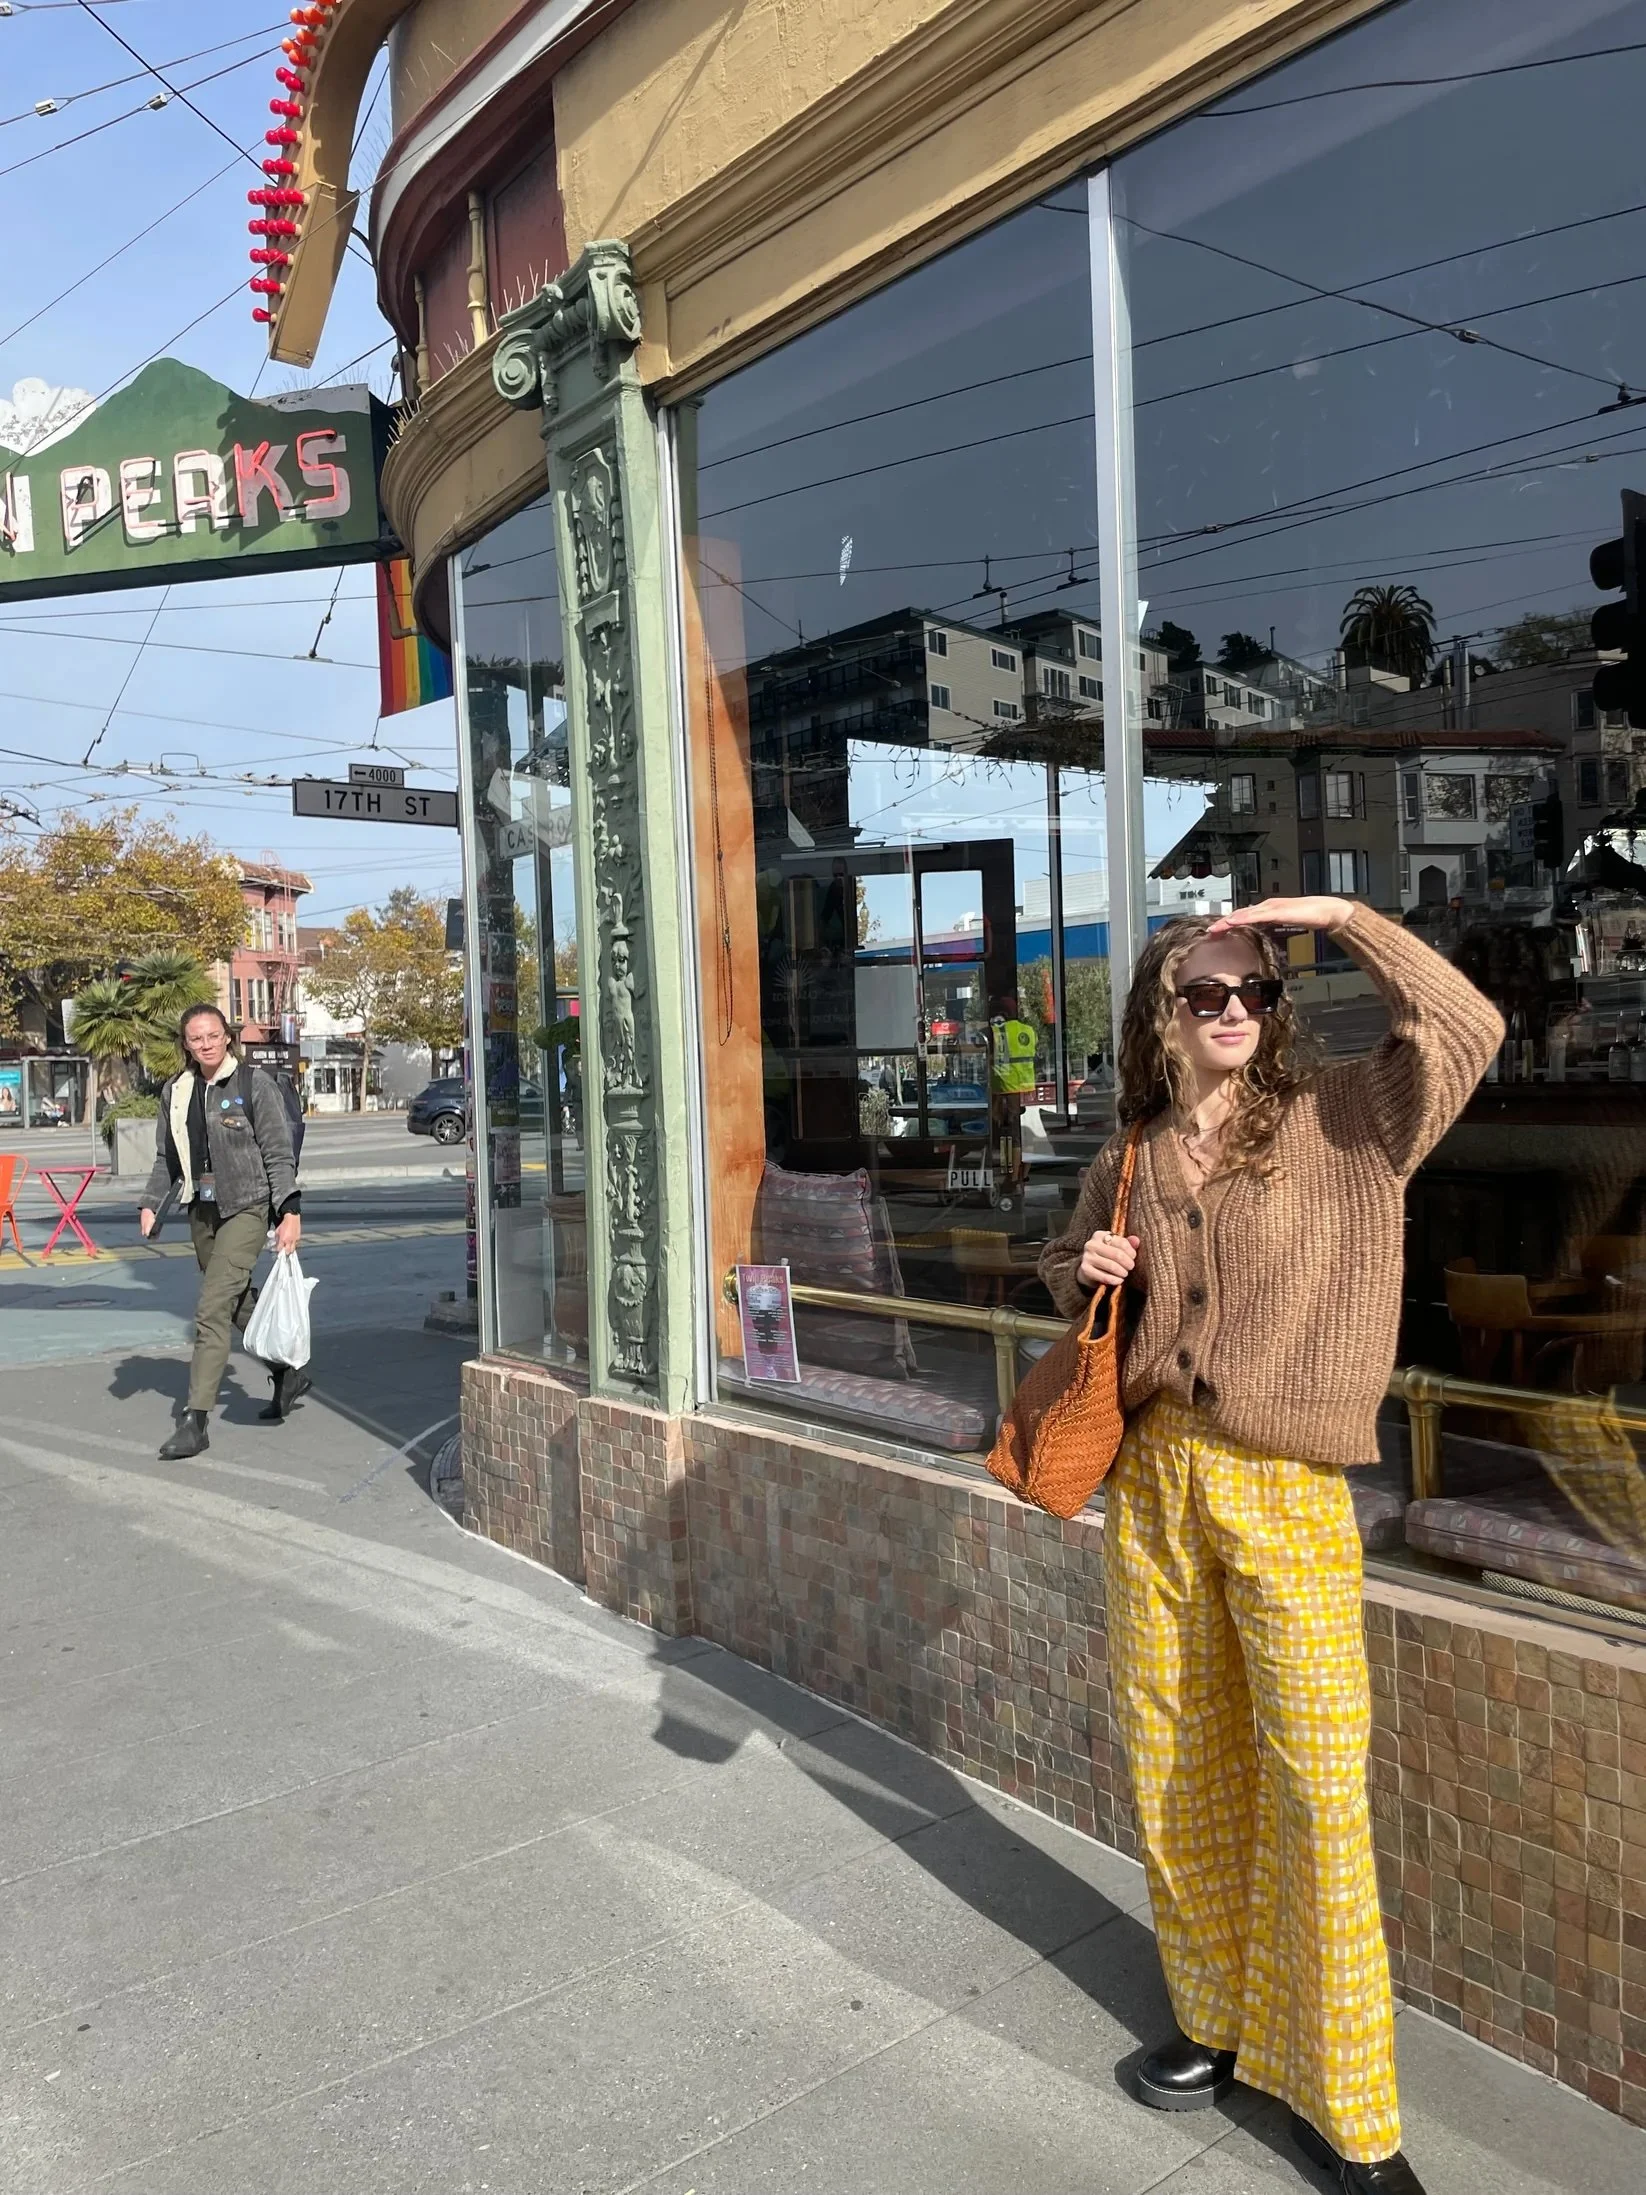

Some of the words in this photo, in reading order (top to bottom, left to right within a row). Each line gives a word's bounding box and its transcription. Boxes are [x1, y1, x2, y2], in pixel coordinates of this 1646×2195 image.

[60, 428, 351, 548] PEAKS
[368, 768, 396, 783] 4000
[324, 789, 381, 813] 17TH
[405, 796, 431, 817] ST
[507, 815, 566, 849] CASRO
[951, 1171, 991, 1187] PULL
